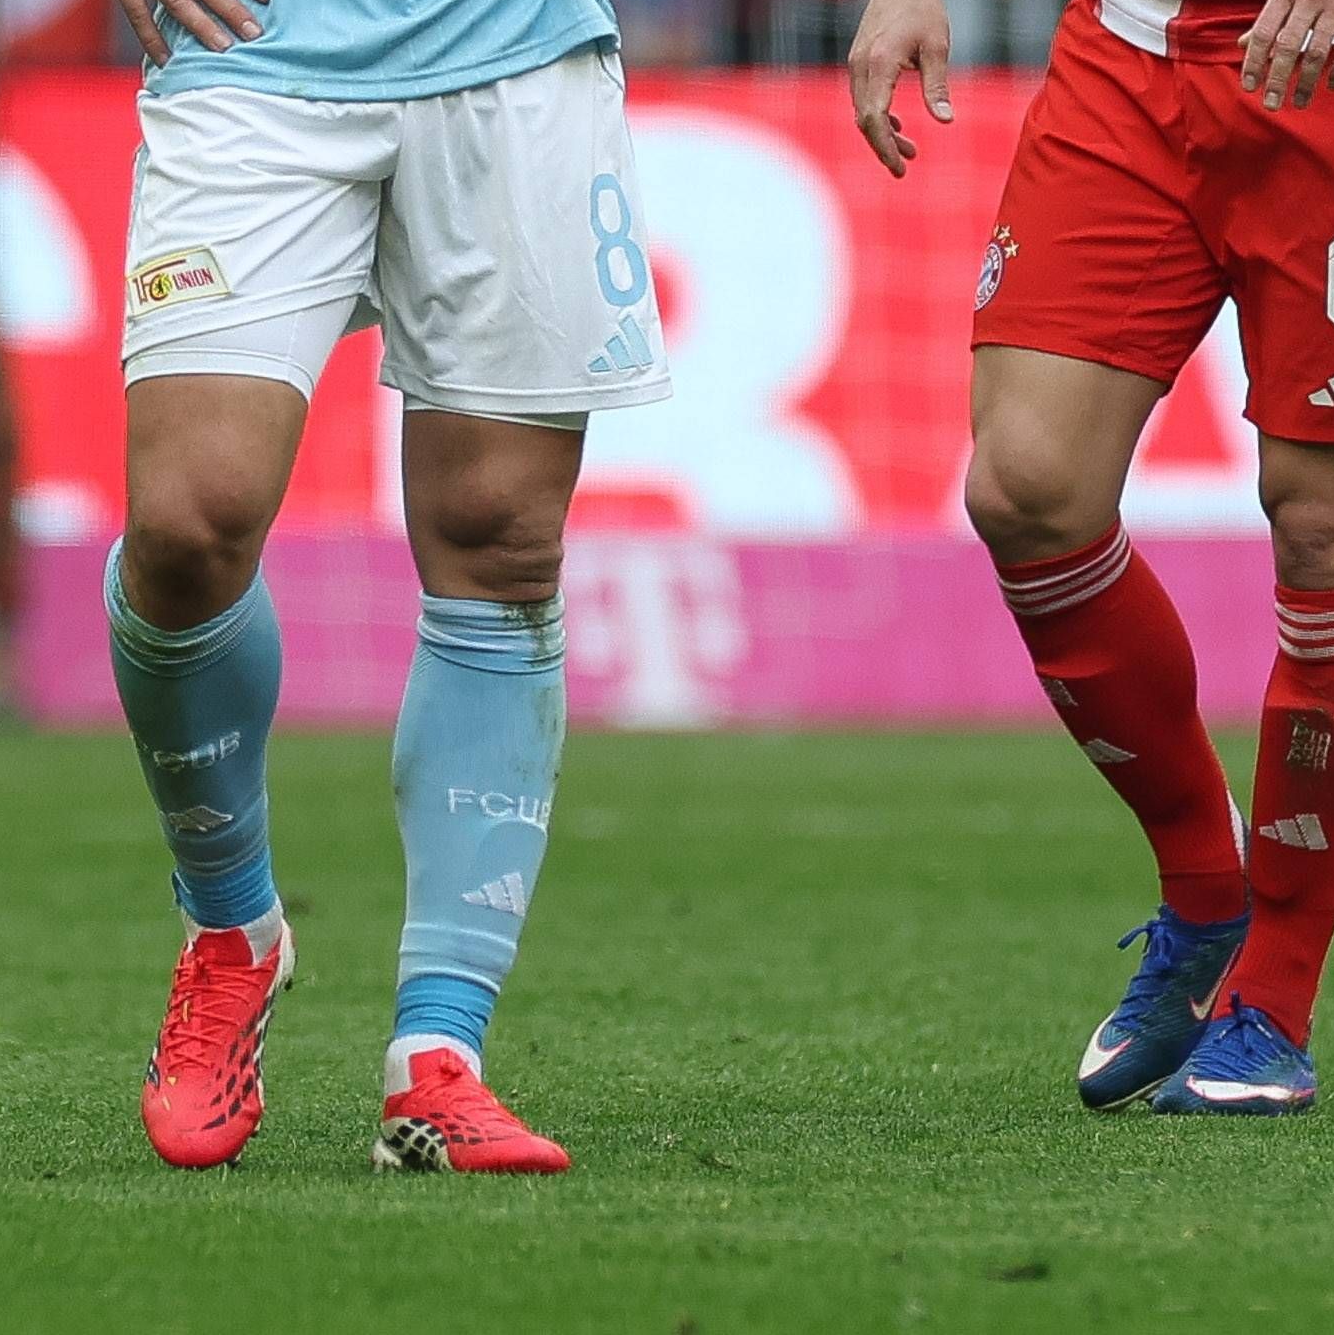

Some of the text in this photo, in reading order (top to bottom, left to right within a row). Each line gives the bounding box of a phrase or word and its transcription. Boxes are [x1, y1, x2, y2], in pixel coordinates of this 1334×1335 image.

[589, 172, 648, 308] 8
[172, 267, 215, 291] UNION
[142, 731, 242, 773] CUB
